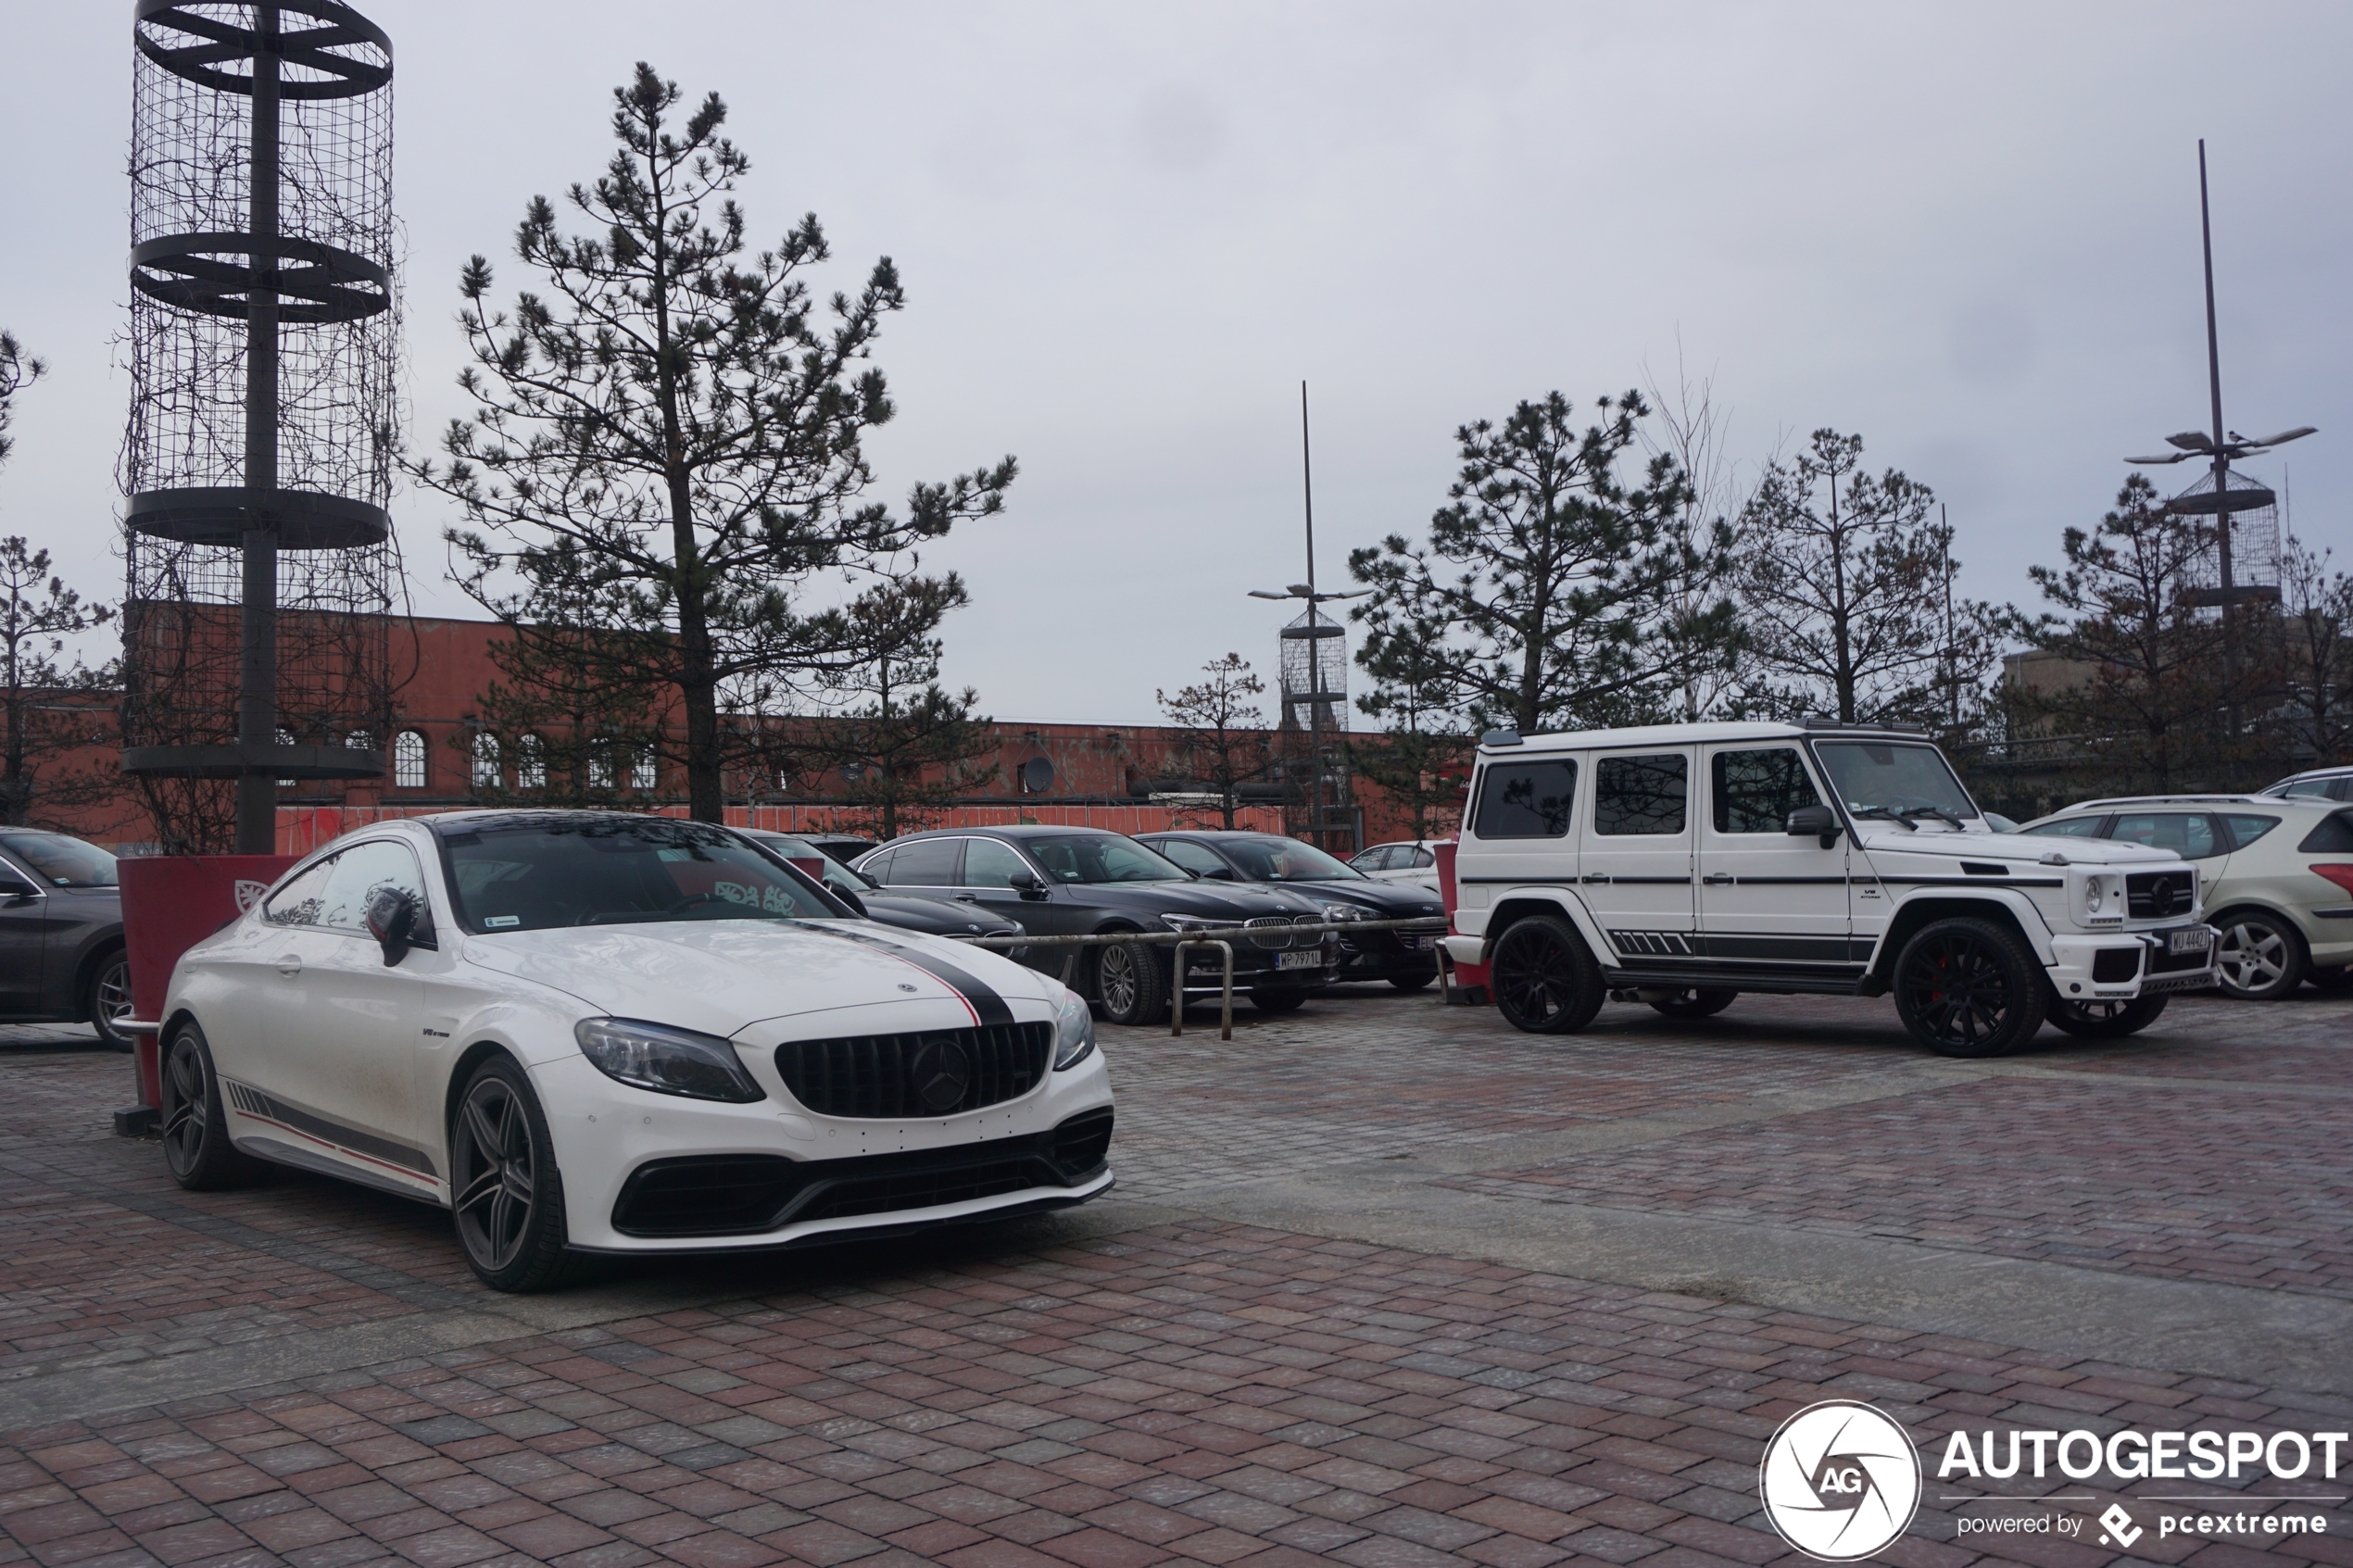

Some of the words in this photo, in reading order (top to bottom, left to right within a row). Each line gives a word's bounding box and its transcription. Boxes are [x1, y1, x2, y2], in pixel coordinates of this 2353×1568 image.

[2173, 933, 2184, 949] WU
[2186, 931, 2207, 948] 4442J
[1281, 954, 1292, 966] WP
[1295, 952, 1319, 965] 7971L
